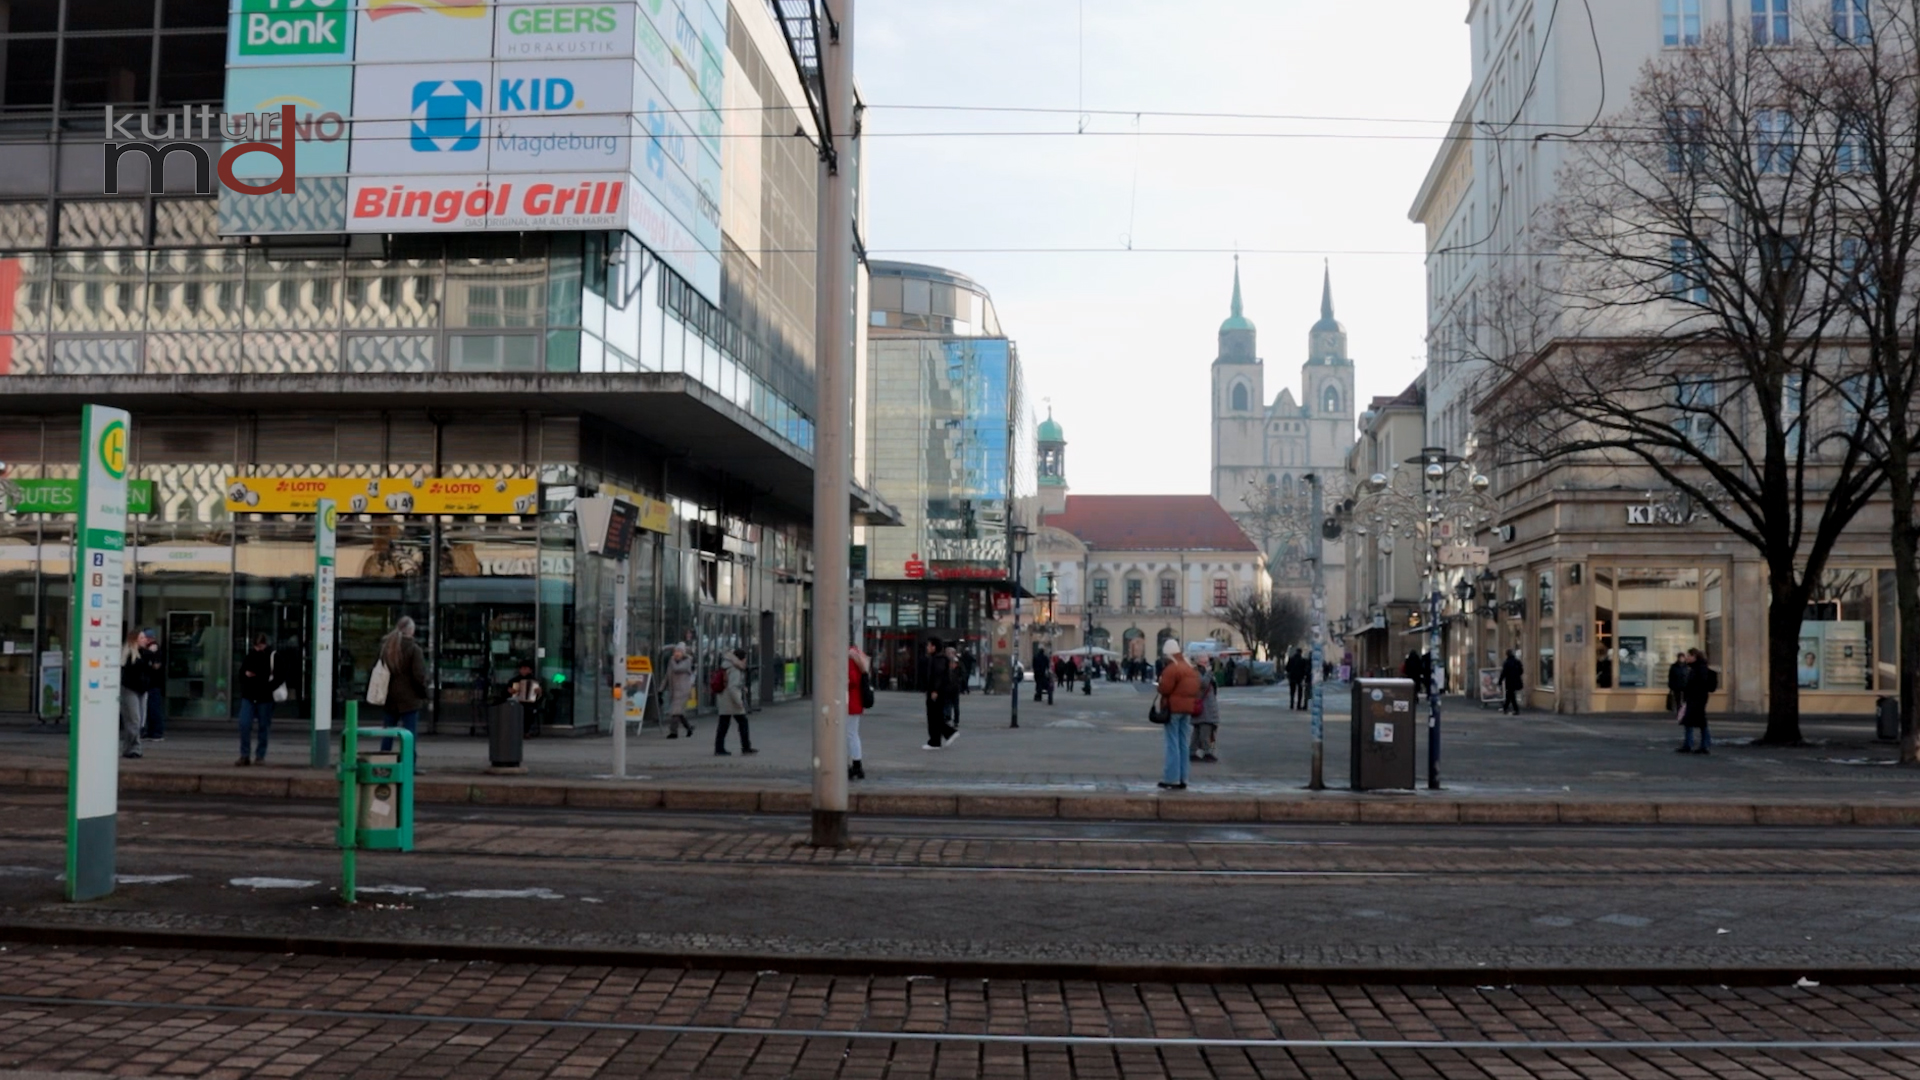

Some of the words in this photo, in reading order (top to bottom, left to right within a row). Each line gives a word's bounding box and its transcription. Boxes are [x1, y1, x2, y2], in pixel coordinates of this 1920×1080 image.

[247, 11, 337, 45] Bank
[508, 6, 617, 35] GEERS
[500, 77, 585, 111] KID.
[497, 132, 617, 157] Magdeburg
[353, 181, 512, 223] Bingöl
[522, 181, 624, 216] Grill
[465, 218, 483, 227] DAS
[487, 217, 529, 226] ORIGINAL
[532, 217, 547, 226] AM
[550, 217, 579, 225] ALTEN
[582, 216, 615, 225] MARKT
[19, 487, 73, 505] GUTES
[291, 482, 326, 491] LOTTO
[445, 484, 481, 493] LOTTO
